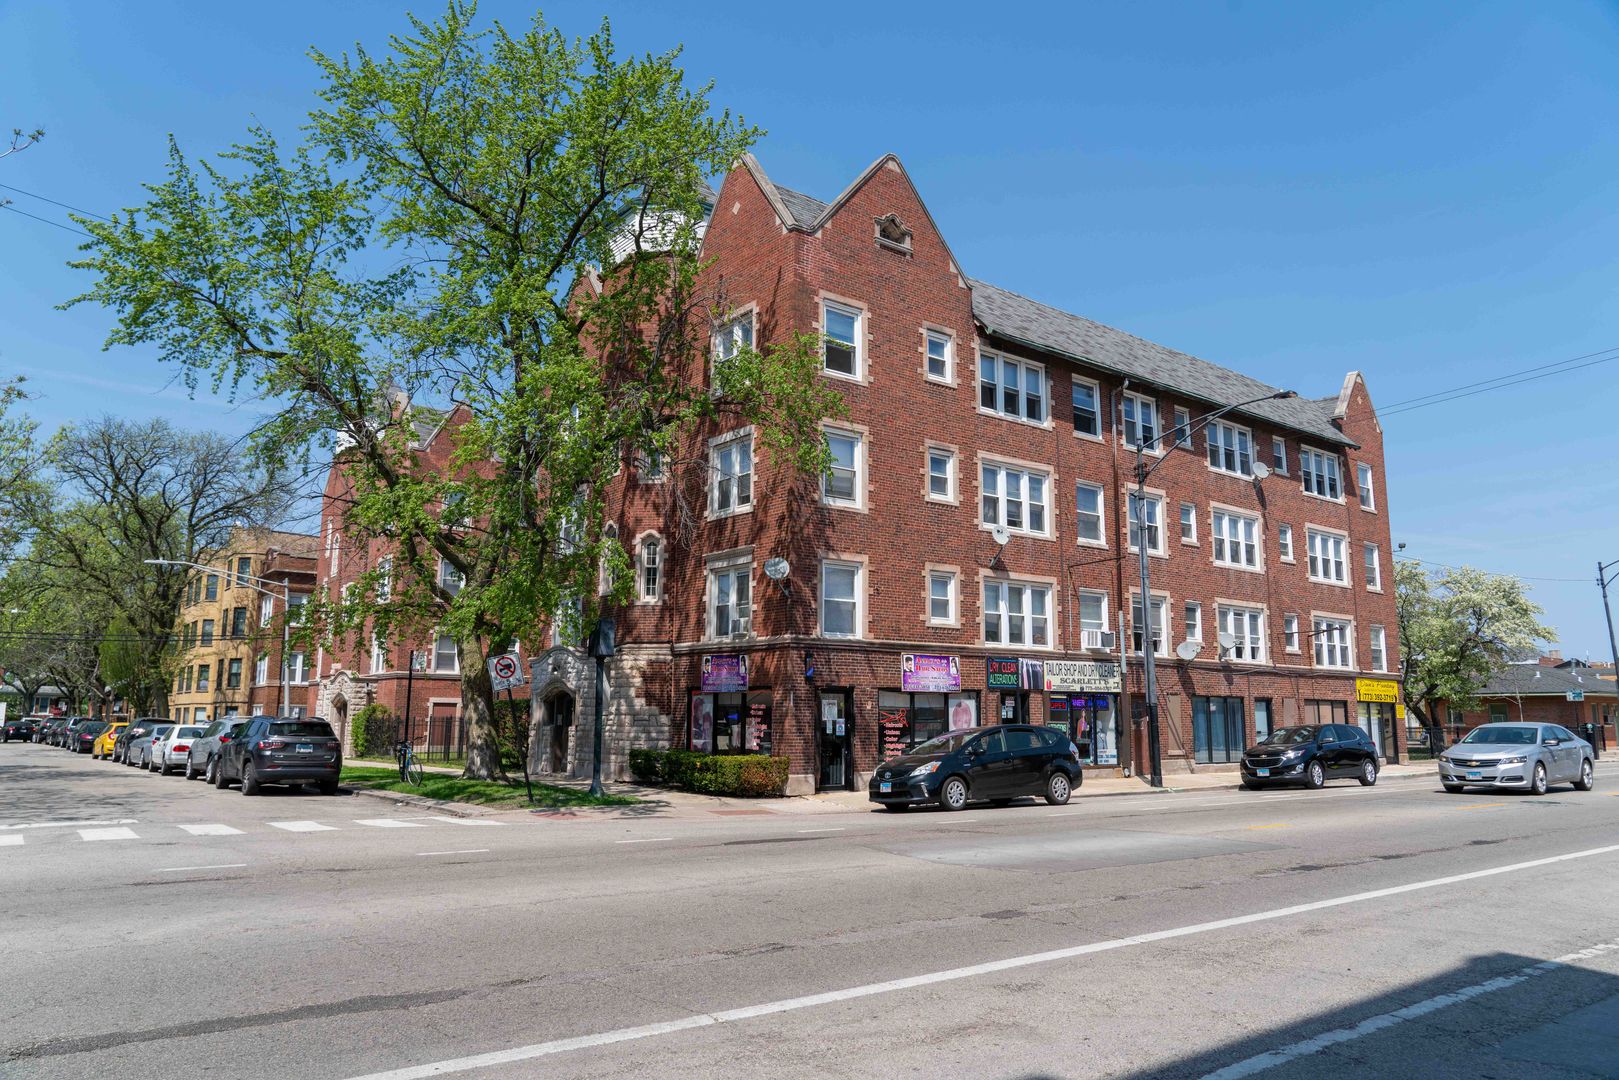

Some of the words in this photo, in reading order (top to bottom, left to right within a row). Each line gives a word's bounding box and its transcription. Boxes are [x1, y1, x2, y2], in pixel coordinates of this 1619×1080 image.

[990, 662, 998, 672] DRY
[1045, 662, 1062, 676] TAILOR
[1063, 663, 1077, 676] SHOP
[1078, 664, 1087, 677] AND
[1088, 664, 1098, 677] DRY
[1059, 677, 1110, 685] SCARLETT'S
[1050, 702, 1066, 710] OPEN
